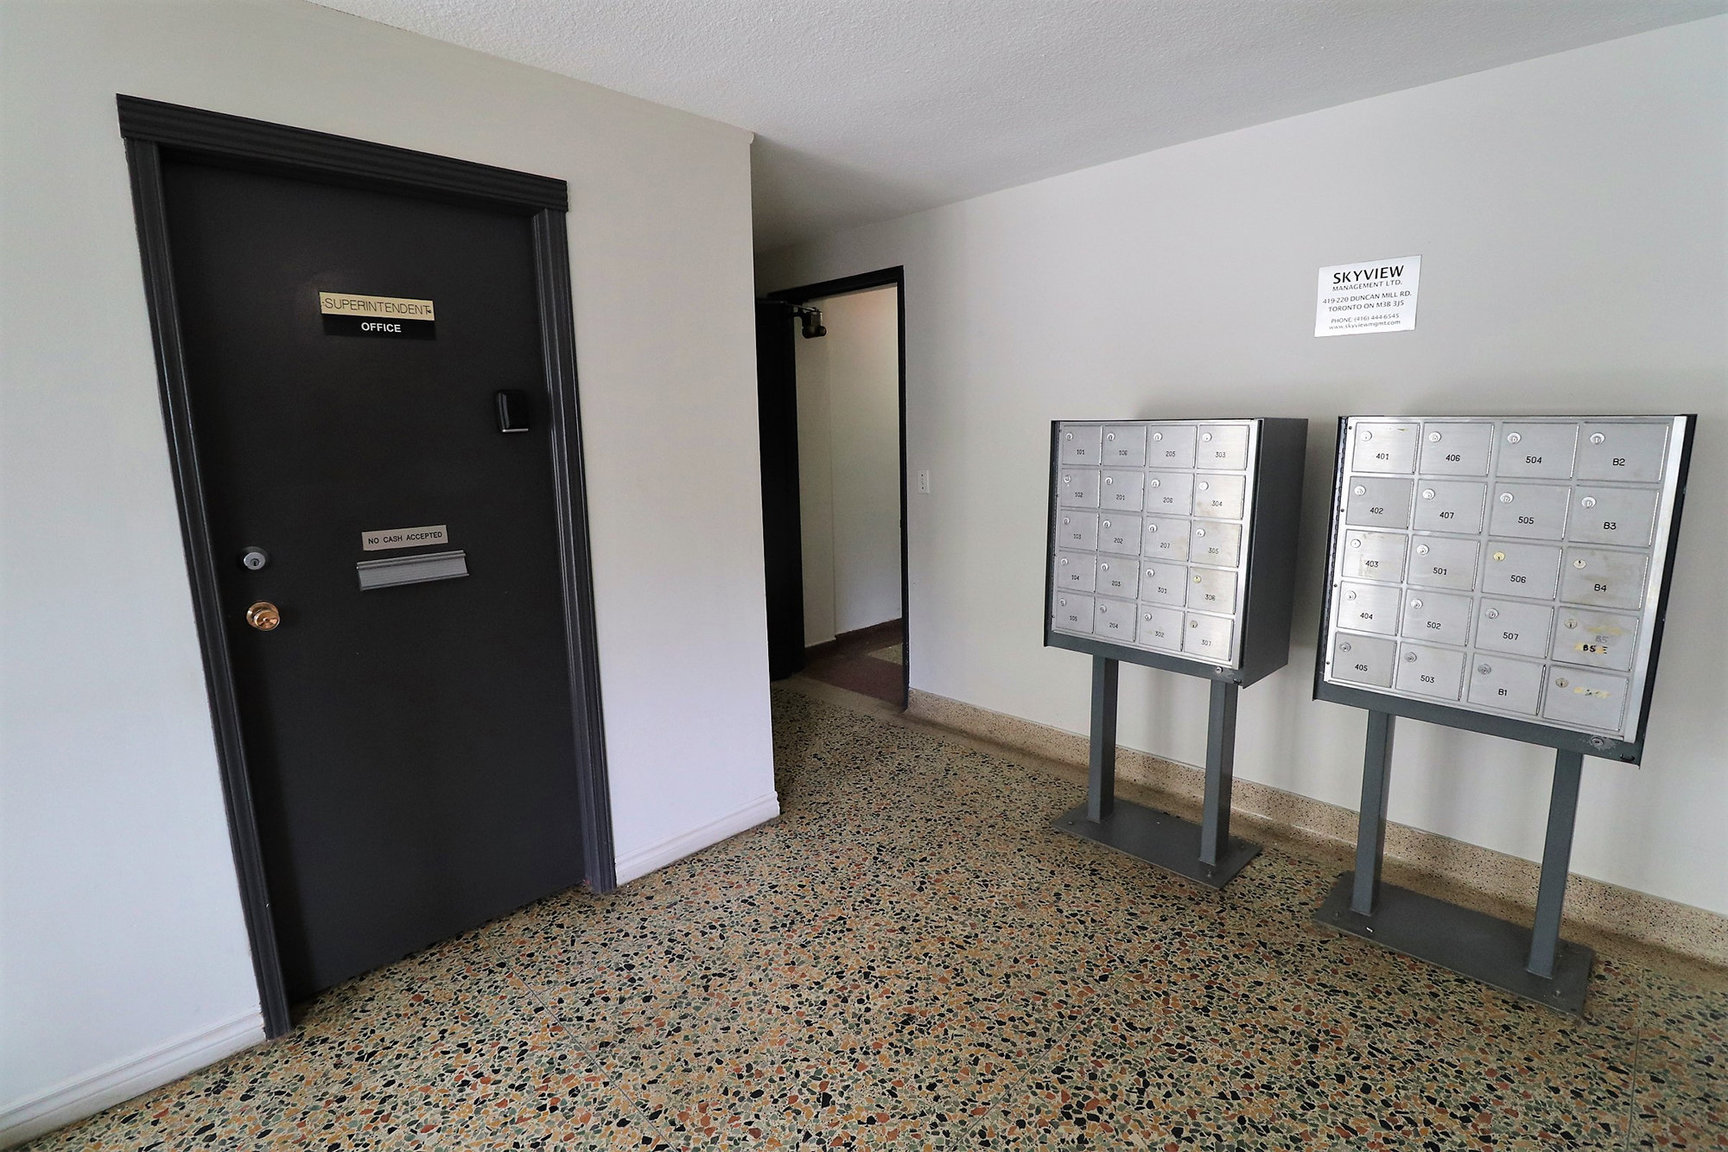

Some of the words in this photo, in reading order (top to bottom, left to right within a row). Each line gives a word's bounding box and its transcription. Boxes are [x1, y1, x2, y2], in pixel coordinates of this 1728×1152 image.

[1332, 265, 1405, 285] SKYVIEW
[1332, 280, 1384, 292] MANAGEMENT
[1385, 279, 1403, 287] LTD.
[1350, 294, 1380, 302] DUNCAN
[1381, 291, 1398, 299] MILL
[324, 298, 431, 315] SUPERINTENDENT
[1328, 304, 1363, 312] TORONTO
[361, 322, 402, 333] OFFICE
[1445, 454, 1460, 462] 406
[1525, 456, 1542, 464] 504
[1613, 458, 1626, 466] B2
[1369, 507, 1384, 515] 402
[1439, 511, 1454, 520] 407
[1518, 516, 1534, 525] 505
[1603, 522, 1617, 530] B3
[368, 537, 380, 545] NO
[383, 535, 403, 544] CASH
[406, 531, 443, 541] ACCEPTED
[1365, 560, 1379, 568] 403
[1433, 567, 1448, 576] 501
[1510, 574, 1527, 584] 506
[1594, 584, 1607, 593] B4
[1360, 612, 1373, 620] 404
[1427, 621, 1442, 630] 502
[1502, 631, 1519, 640] 507
[1354, 664, 1368, 672] 405
[1420, 675, 1435, 683] 503
